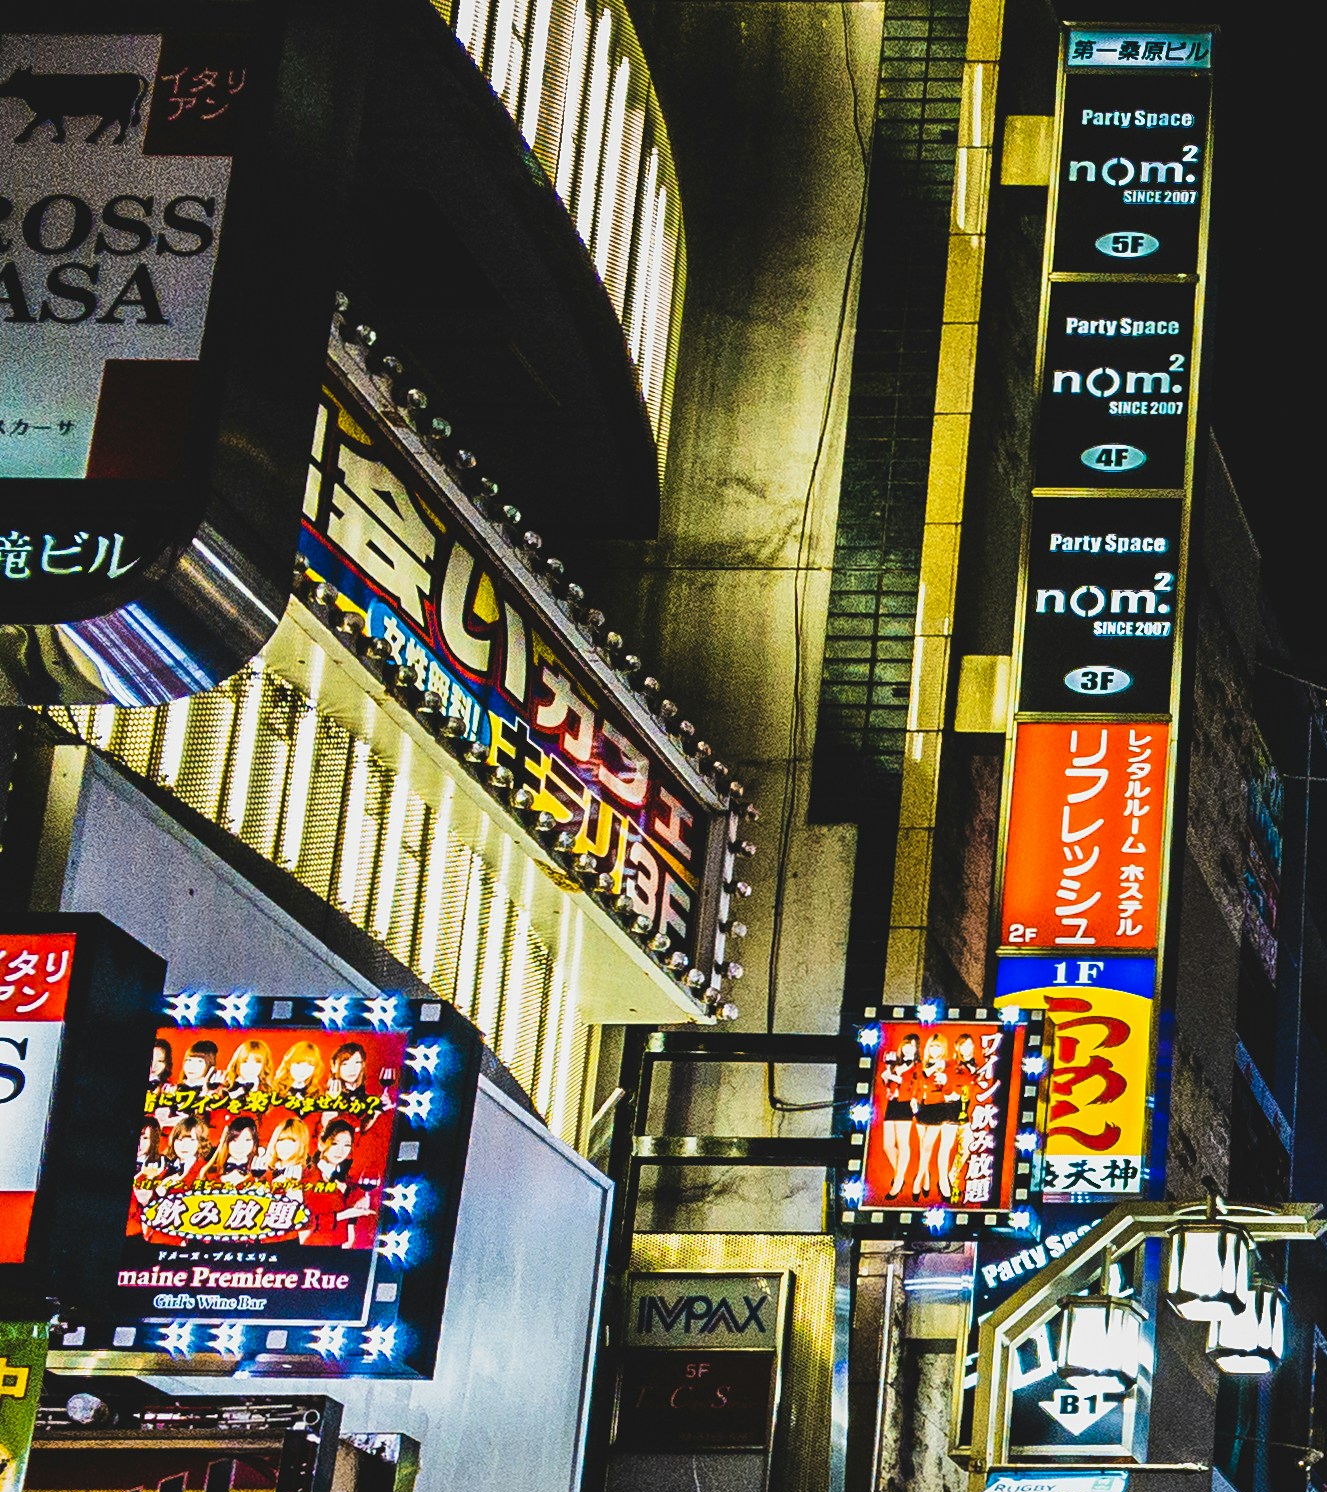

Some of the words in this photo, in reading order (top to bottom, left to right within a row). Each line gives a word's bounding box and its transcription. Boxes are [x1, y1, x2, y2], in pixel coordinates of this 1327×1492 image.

[1072, 39, 1211, 63] 第一桑原ビル
[168, 97, 230, 120] アン
[1081, 109, 1132, 131] Party
[1136, 109, 1194, 129] Space
[1123, 190, 1161, 204] SINCE
[1164, 190, 1196, 204] 2007
[1111, 235, 1144, 254] 5F
[1066, 317, 1117, 339] Party
[1119, 317, 1180, 337] Space
[1108, 401, 1147, 415] SINCE
[1149, 401, 1183, 415] 2007
[1096, 448, 1129, 467] 4F
[1049, 533, 1100, 555] Party
[1104, 534, 1166, 554] Space
[1093, 621, 1132, 636] SINCE
[1134, 621, 1170, 636] 2007
[1079, 671, 1114, 691] 3F
[1123, 729, 1152, 853] レンタルルーム
[1054, 729, 1108, 945] リフレッシュ
[1115, 864, 1145, 936] ホステル
[1008, 925, 1038, 942] 2F
[1053, 962, 1105, 984] 1F
[150, 1199, 297, 1230] 飲み放題
[981, 1246, 1049, 1289] Party
[192, 1267, 298, 1290] Premiere
[302, 1268, 349, 1291] Rue
[197, 1294, 235, 1311] Wine
[237, 1294, 267, 1311] Bar
[1059, 1395, 1097, 1415] B1
